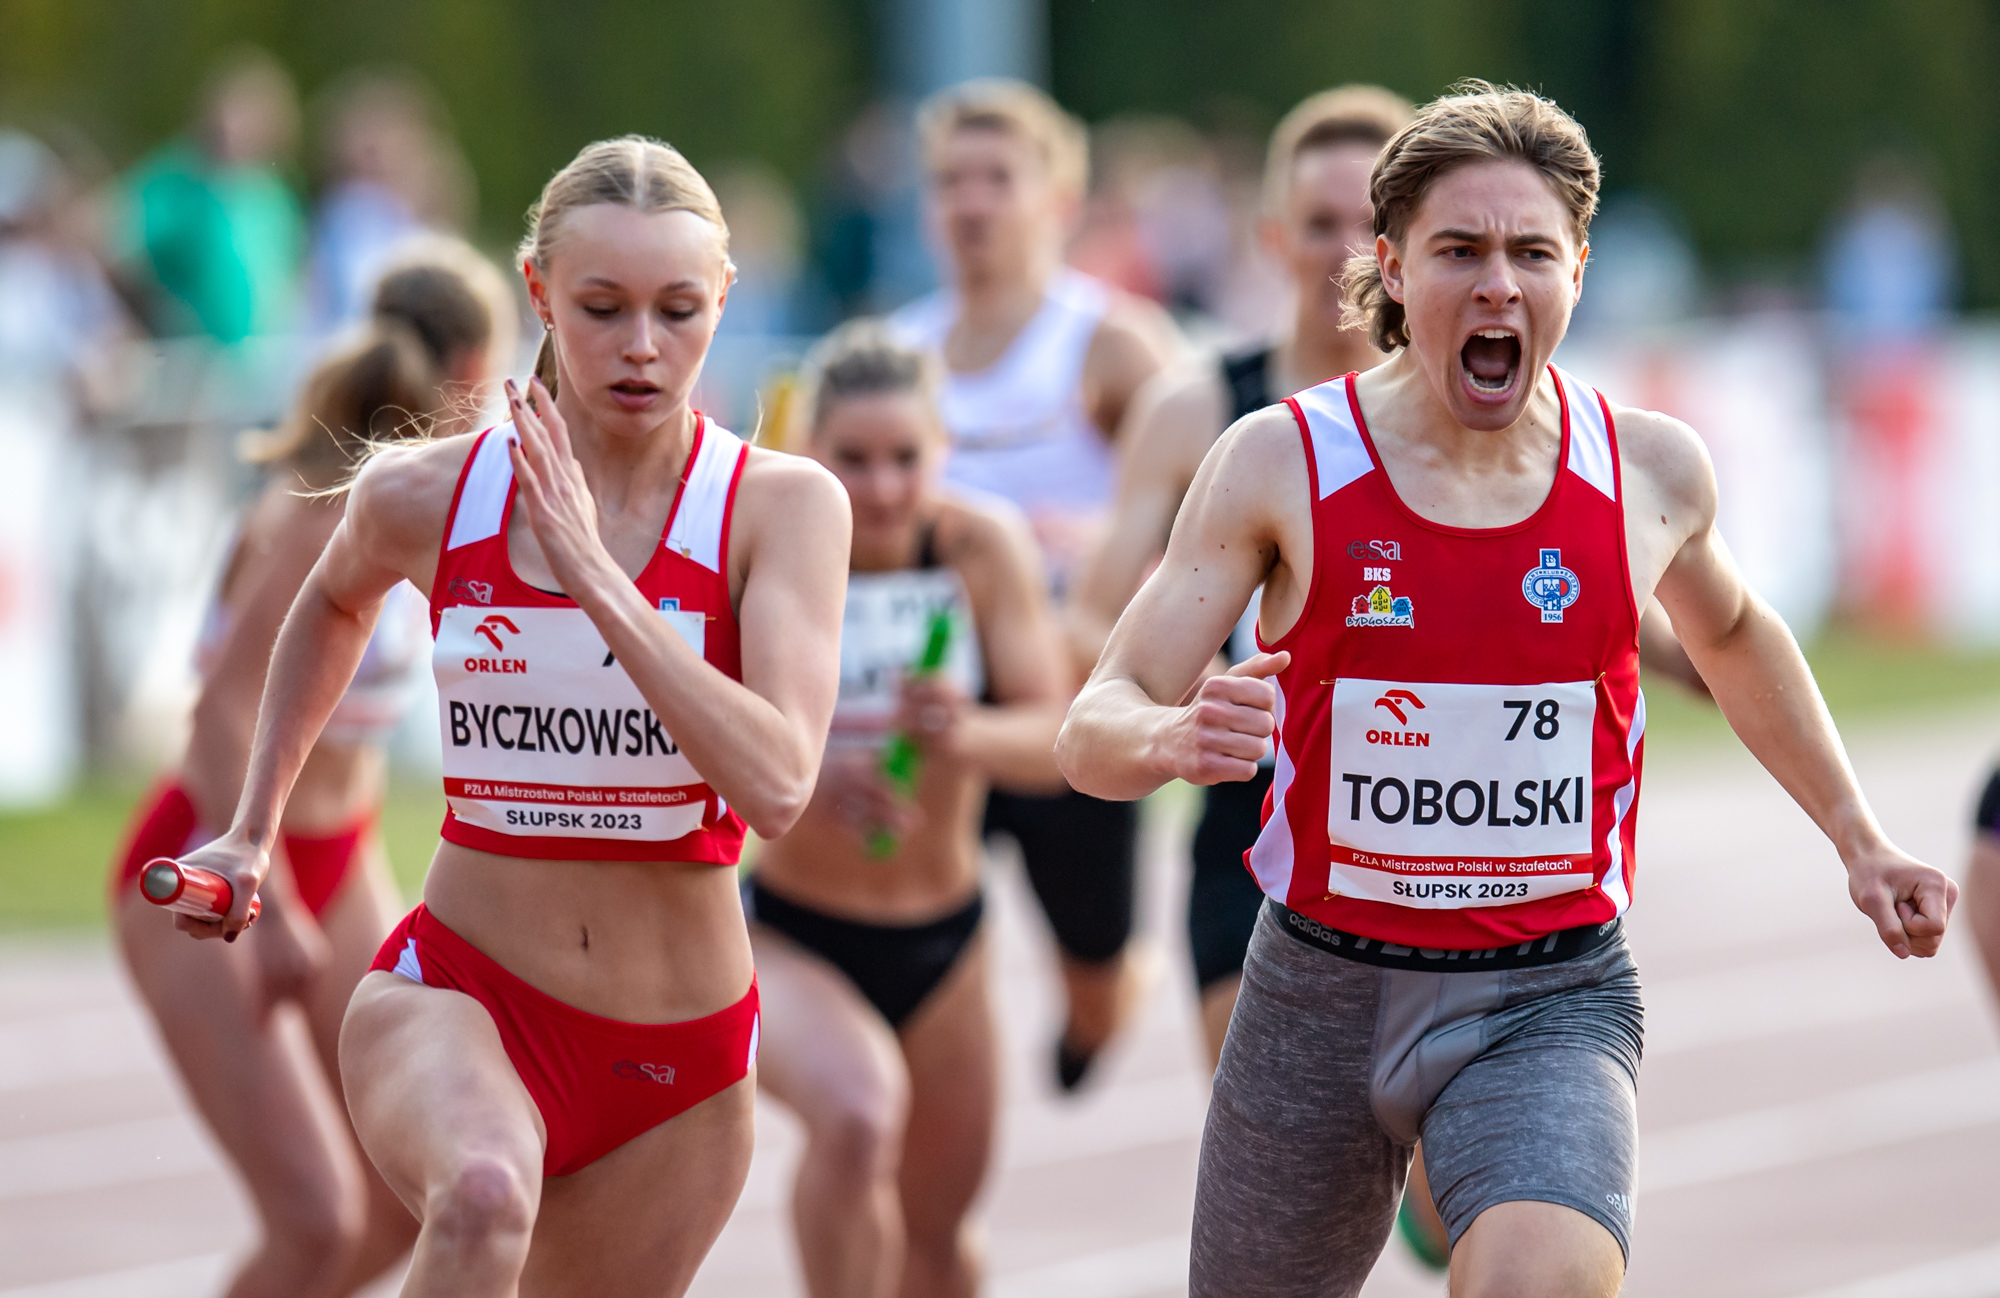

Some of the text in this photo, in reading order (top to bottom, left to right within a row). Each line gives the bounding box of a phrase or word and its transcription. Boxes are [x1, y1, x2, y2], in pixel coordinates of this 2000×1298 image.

[1363, 567, 1391, 581] BKS
[1346, 616, 1410, 626] BYDGOSZCZ
[1544, 613, 1562, 621] 1956
[464, 658, 527, 673] ORLEN
[450, 701, 678, 756] BYCZKOWSK
[1503, 699, 1560, 741] 78
[1366, 730, 1430, 747] ORLEN
[464, 783, 687, 803] PZLA Mistrzostwa Polski w Sztafetach
[1342, 773, 1584, 827] TOBOLSKI
[506, 810, 642, 830] SŁUPSK 2023
[1352, 852, 1573, 873] PZLA Mistrzostwa Polski w Sztafetach
[1393, 881, 1529, 899] SŁUPSK 2023
[1289, 913, 1341, 946] adidas
